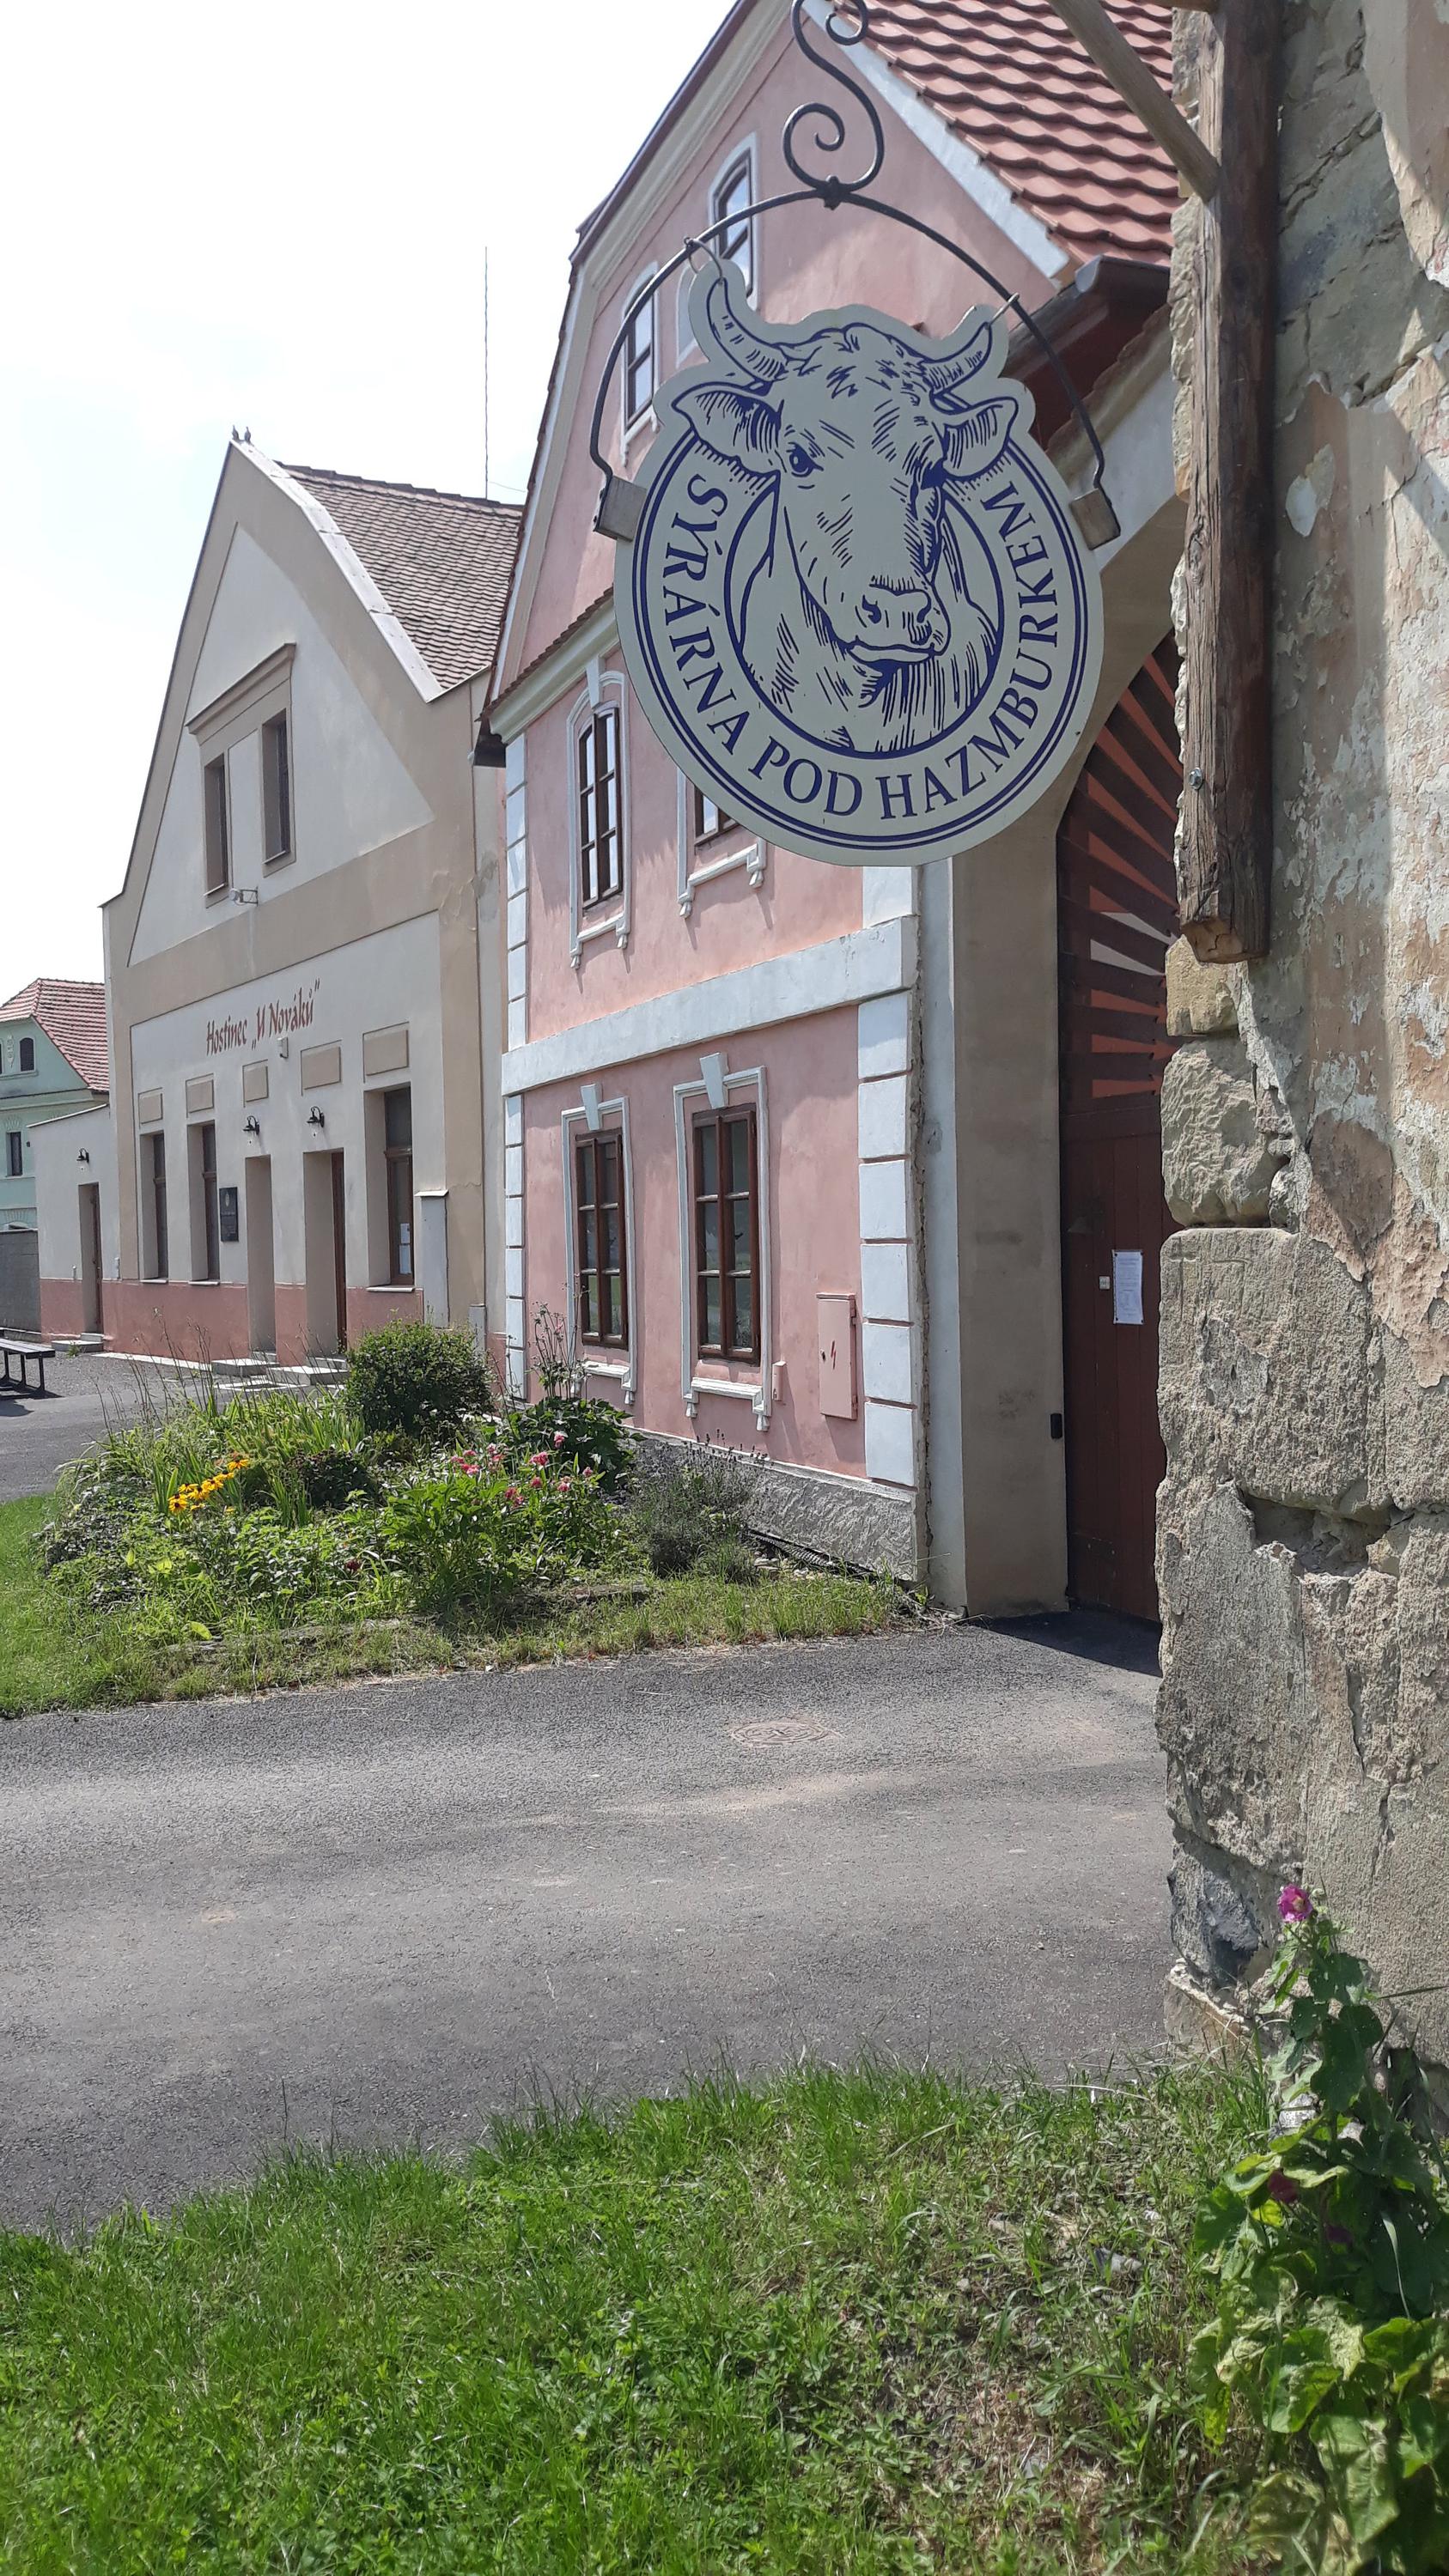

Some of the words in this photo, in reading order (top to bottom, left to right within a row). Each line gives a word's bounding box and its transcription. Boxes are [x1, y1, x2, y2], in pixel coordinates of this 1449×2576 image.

[662, 475, 750, 754] SÝRÁRNA
[749, 736, 862, 817] POD
[875, 480, 1058, 820] HAZMBURKEM
[206, 1015, 247, 1056] Hostinec
